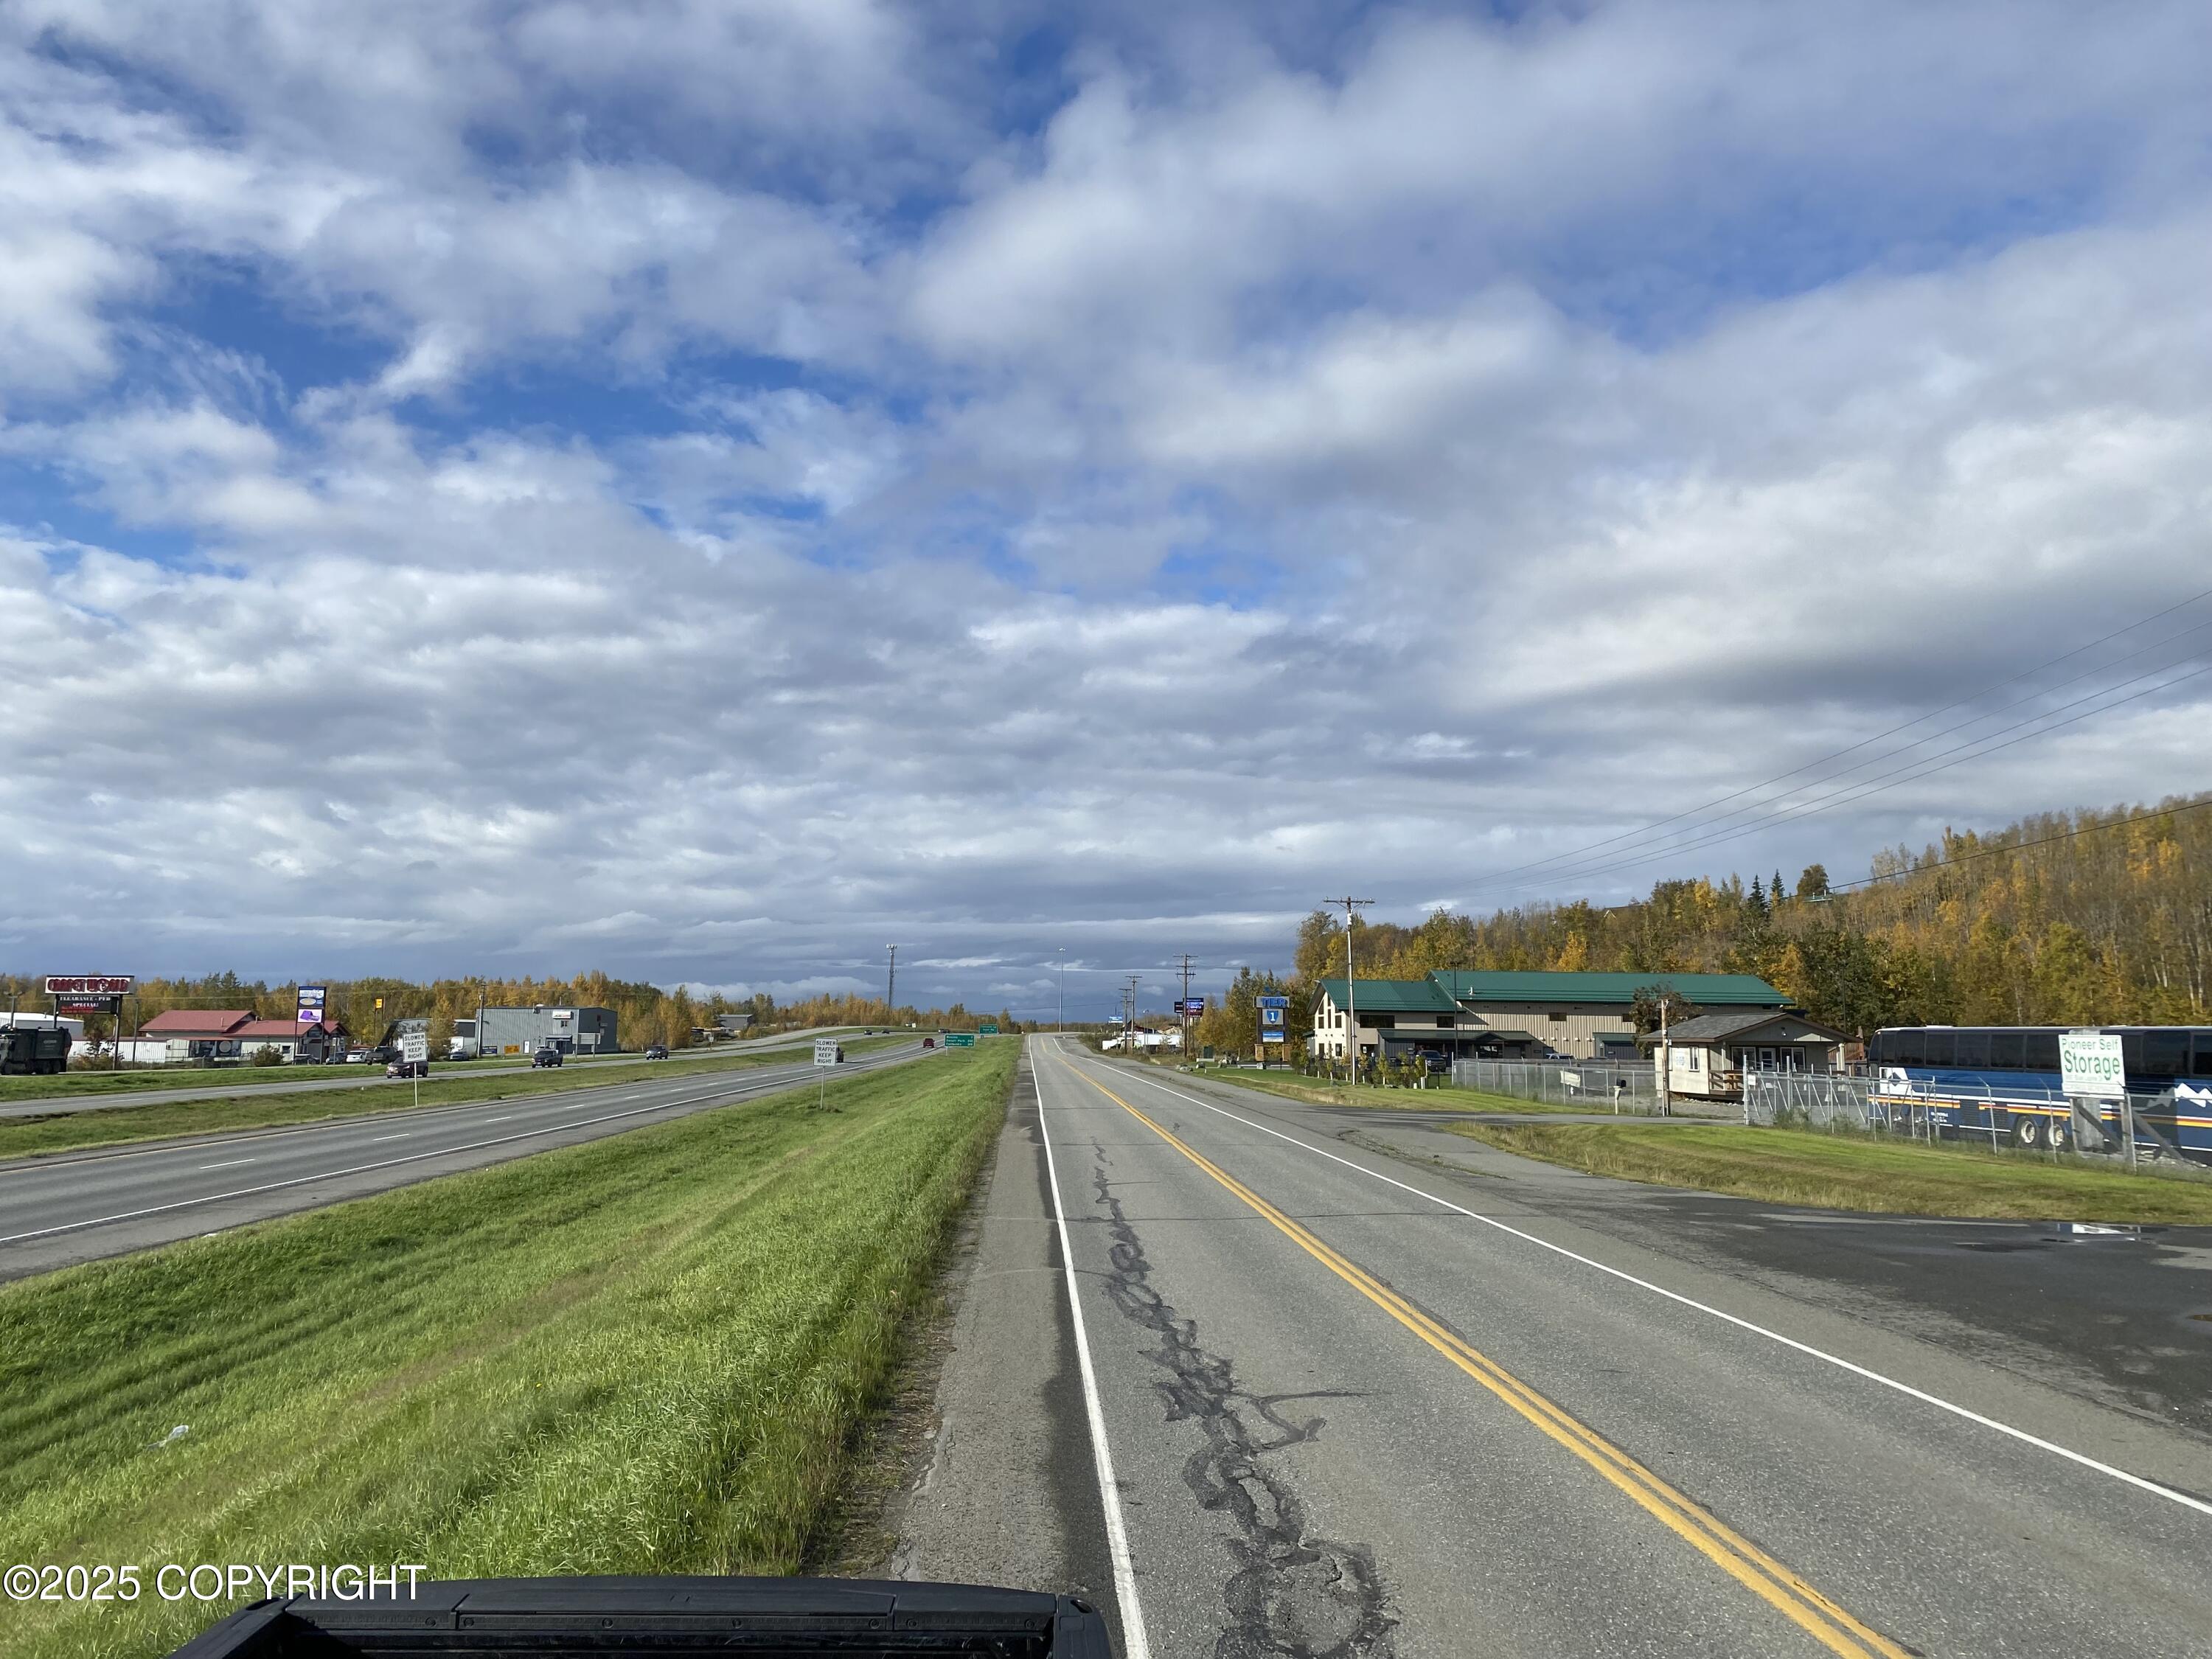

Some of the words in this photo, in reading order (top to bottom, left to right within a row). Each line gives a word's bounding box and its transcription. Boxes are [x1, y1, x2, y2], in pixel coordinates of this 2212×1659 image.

[1262, 998, 1287, 1007] TIER
[1270, 1012, 1276, 1021] 1
[2062, 1038, 2096, 1050] Pioneer
[2099, 1038, 2118, 1050] Self
[2064, 1050, 2121, 1081] Storage
